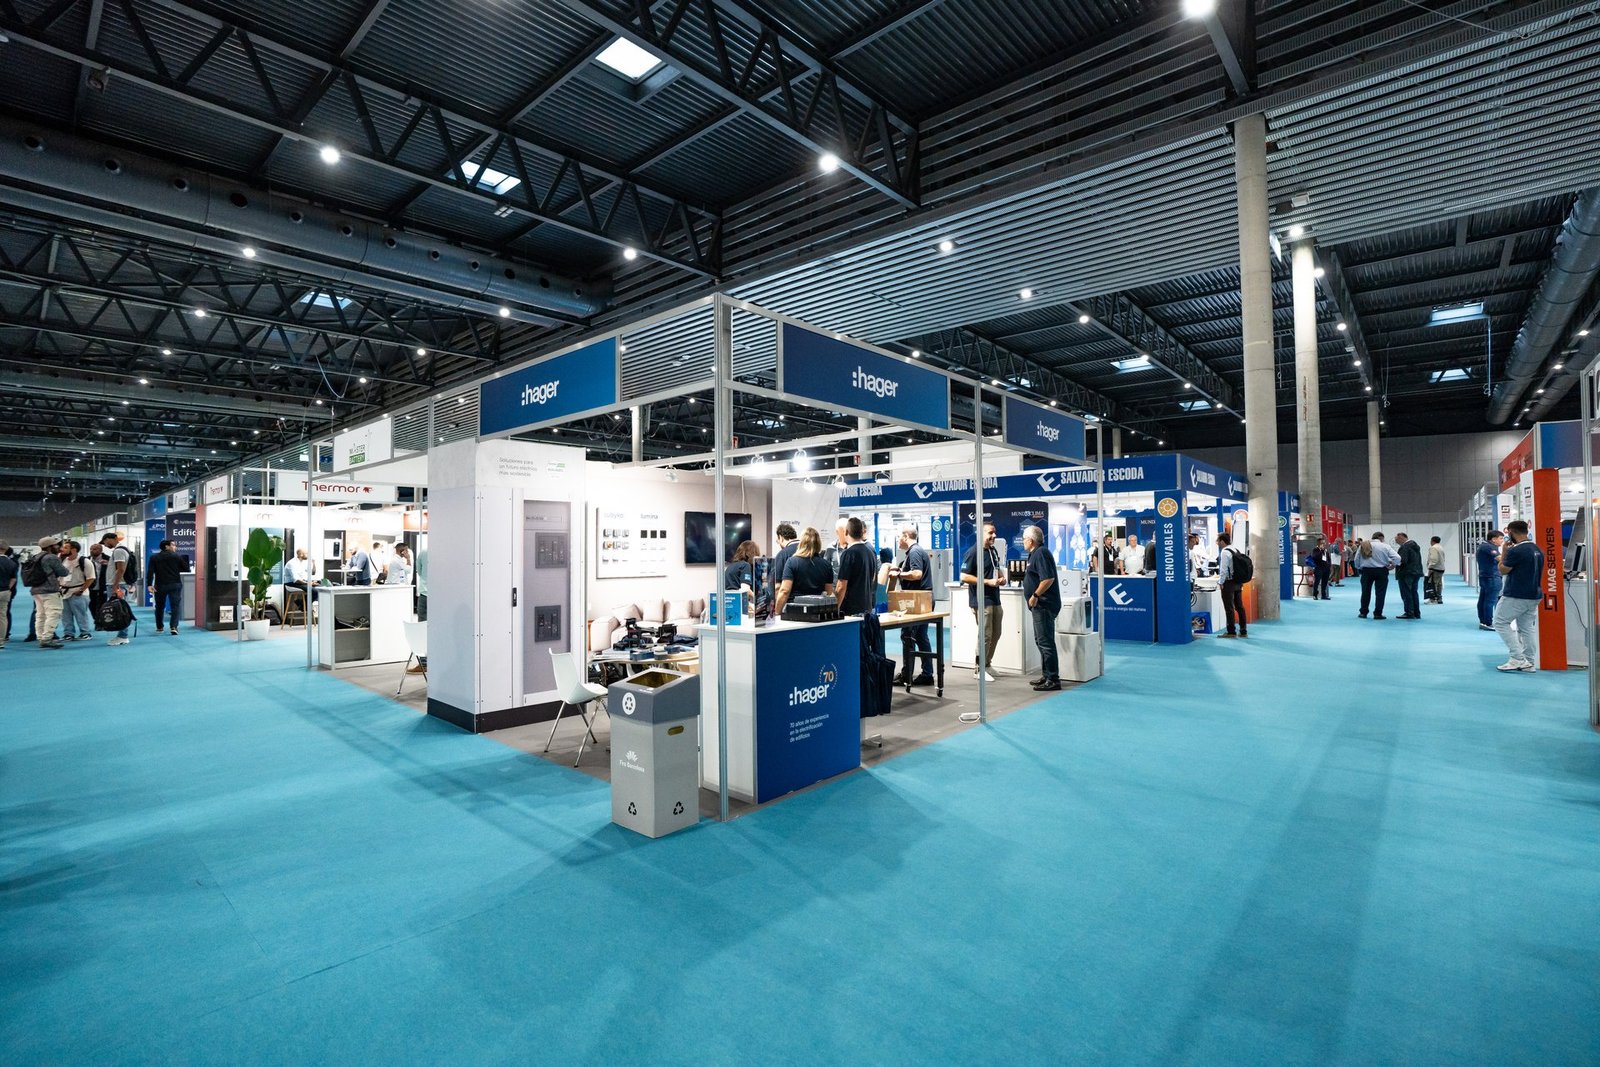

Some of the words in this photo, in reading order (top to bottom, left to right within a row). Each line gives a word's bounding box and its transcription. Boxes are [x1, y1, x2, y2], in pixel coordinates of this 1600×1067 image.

[852, 365, 899, 398] :hager
[521, 380, 560, 406] :hager
[1037, 420, 1060, 442] :hager
[1108, 467, 1144, 481] ESCODA
[932, 479, 968, 492] SALVADOR
[1164, 522, 1175, 582] RENOVABLES
[822, 671, 835, 683] 70
[789, 683, 830, 706] :hager
